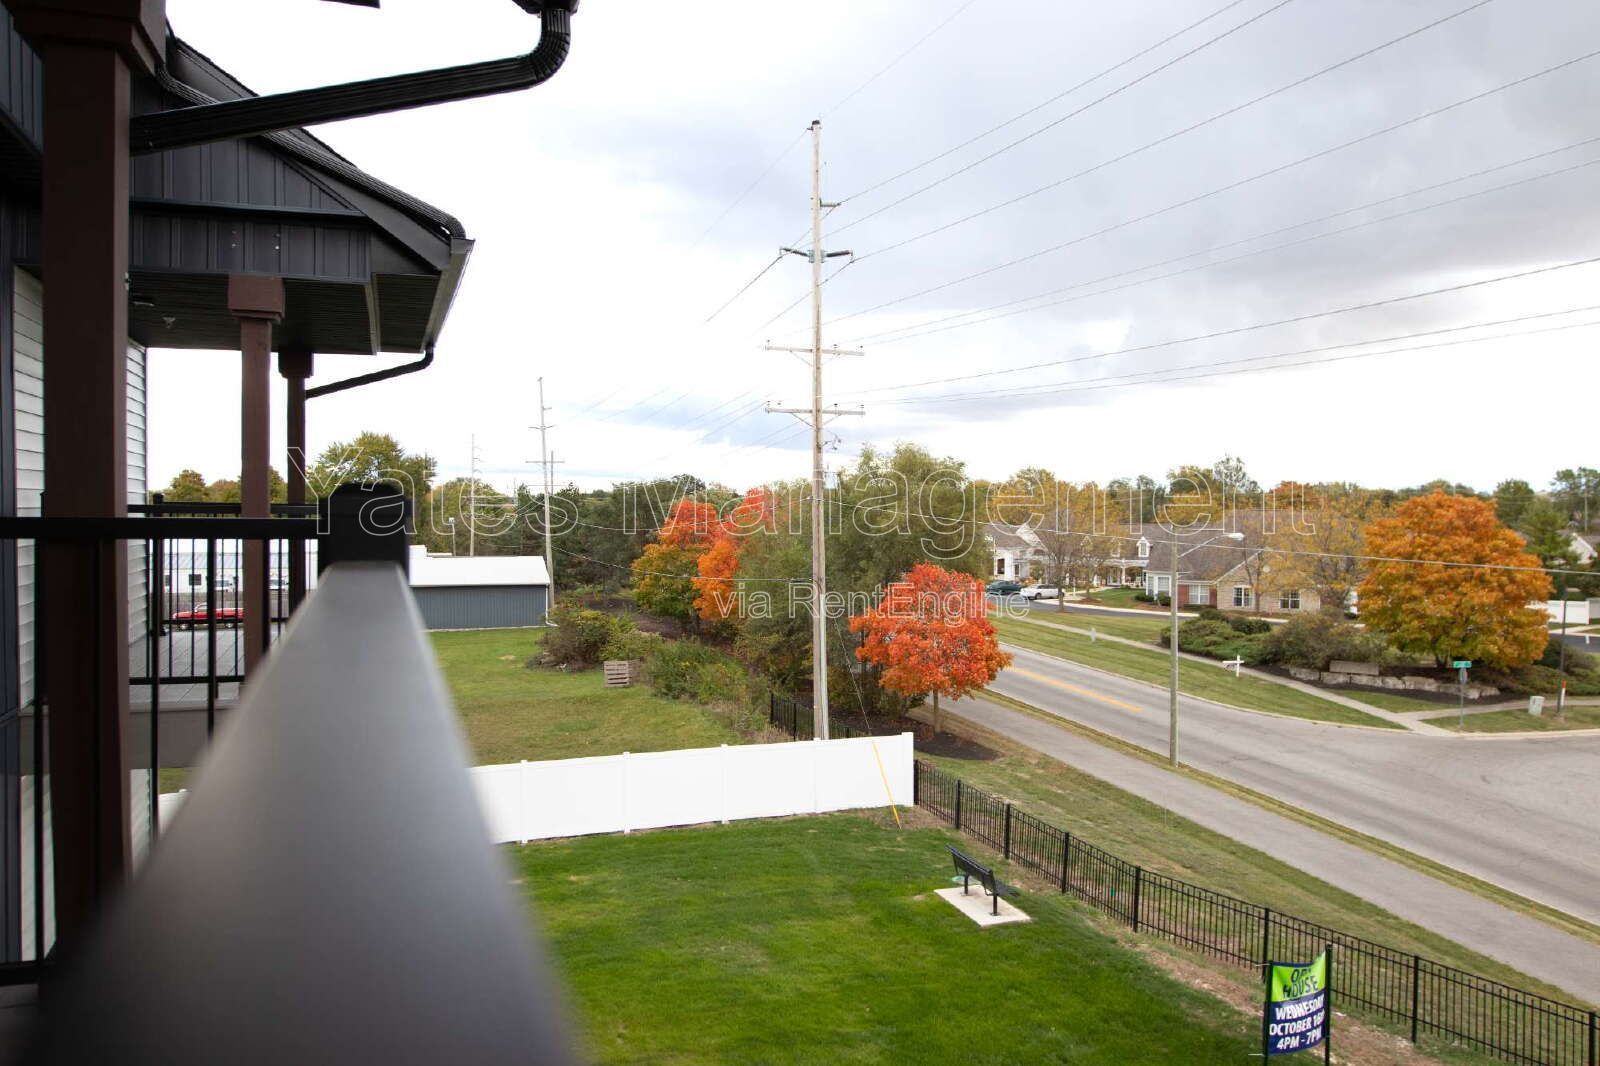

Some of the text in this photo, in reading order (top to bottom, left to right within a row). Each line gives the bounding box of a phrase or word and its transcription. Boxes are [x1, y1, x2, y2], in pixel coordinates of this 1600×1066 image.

[1283, 975, 1319, 998] HOUSE
[1269, 1015, 1312, 1036] OCTOBER
[1276, 1036, 1300, 1050] 4PM
[1306, 1026, 1322, 1045] 7PM
